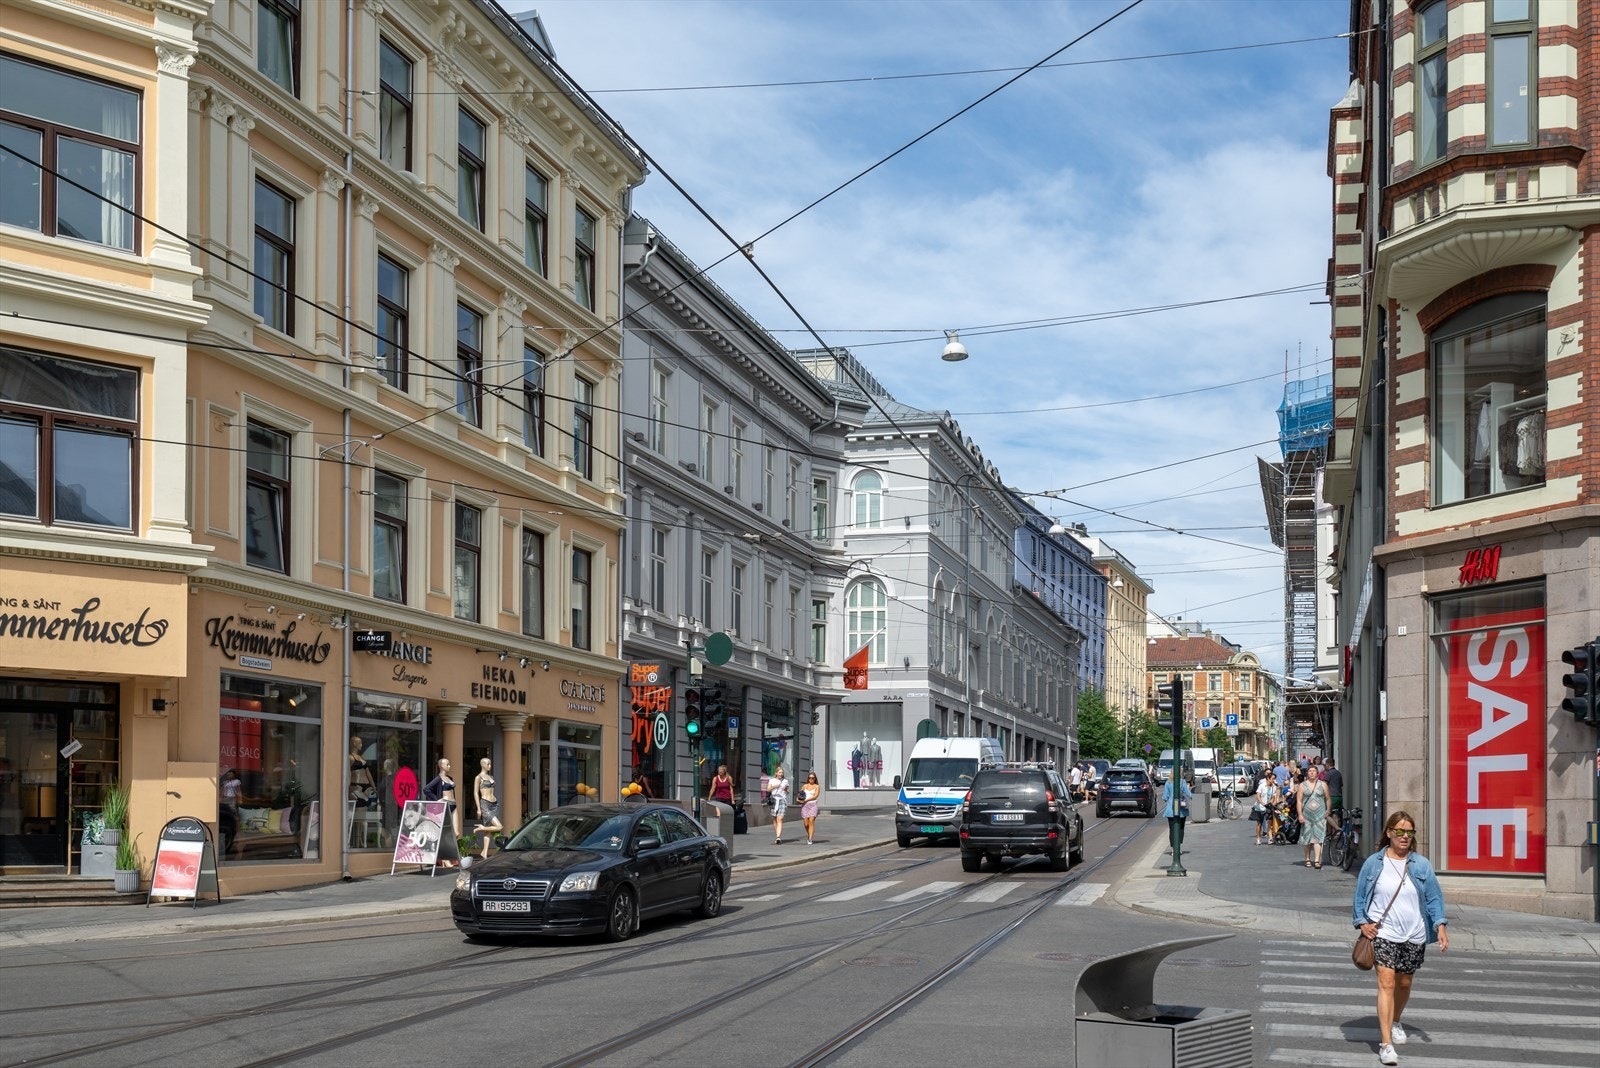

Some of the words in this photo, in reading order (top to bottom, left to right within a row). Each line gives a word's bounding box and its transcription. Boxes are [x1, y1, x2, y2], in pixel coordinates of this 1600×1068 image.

[21, 599, 30, 608] &
[33, 598, 61, 611] SÅNT
[239, 616, 254, 627] TING
[205, 615, 330, 665] Kremmerhuset
[241, 658, 271, 669] Bogstadveien
[631, 663, 659, 674] Super
[392, 664, 428, 688] Lingerie
[482, 664, 516, 685] HEKA
[471, 682, 527, 705] EIENDOM
[559, 679, 606, 705] CARRÉ
[1466, 625, 1530, 860] SALE
[239, 746, 261, 759] SALG
[846, 759, 884, 771] SALE
[158, 864, 196, 877] SALG
[485, 901, 496, 910] AR
[500, 902, 528, 911] 95293
